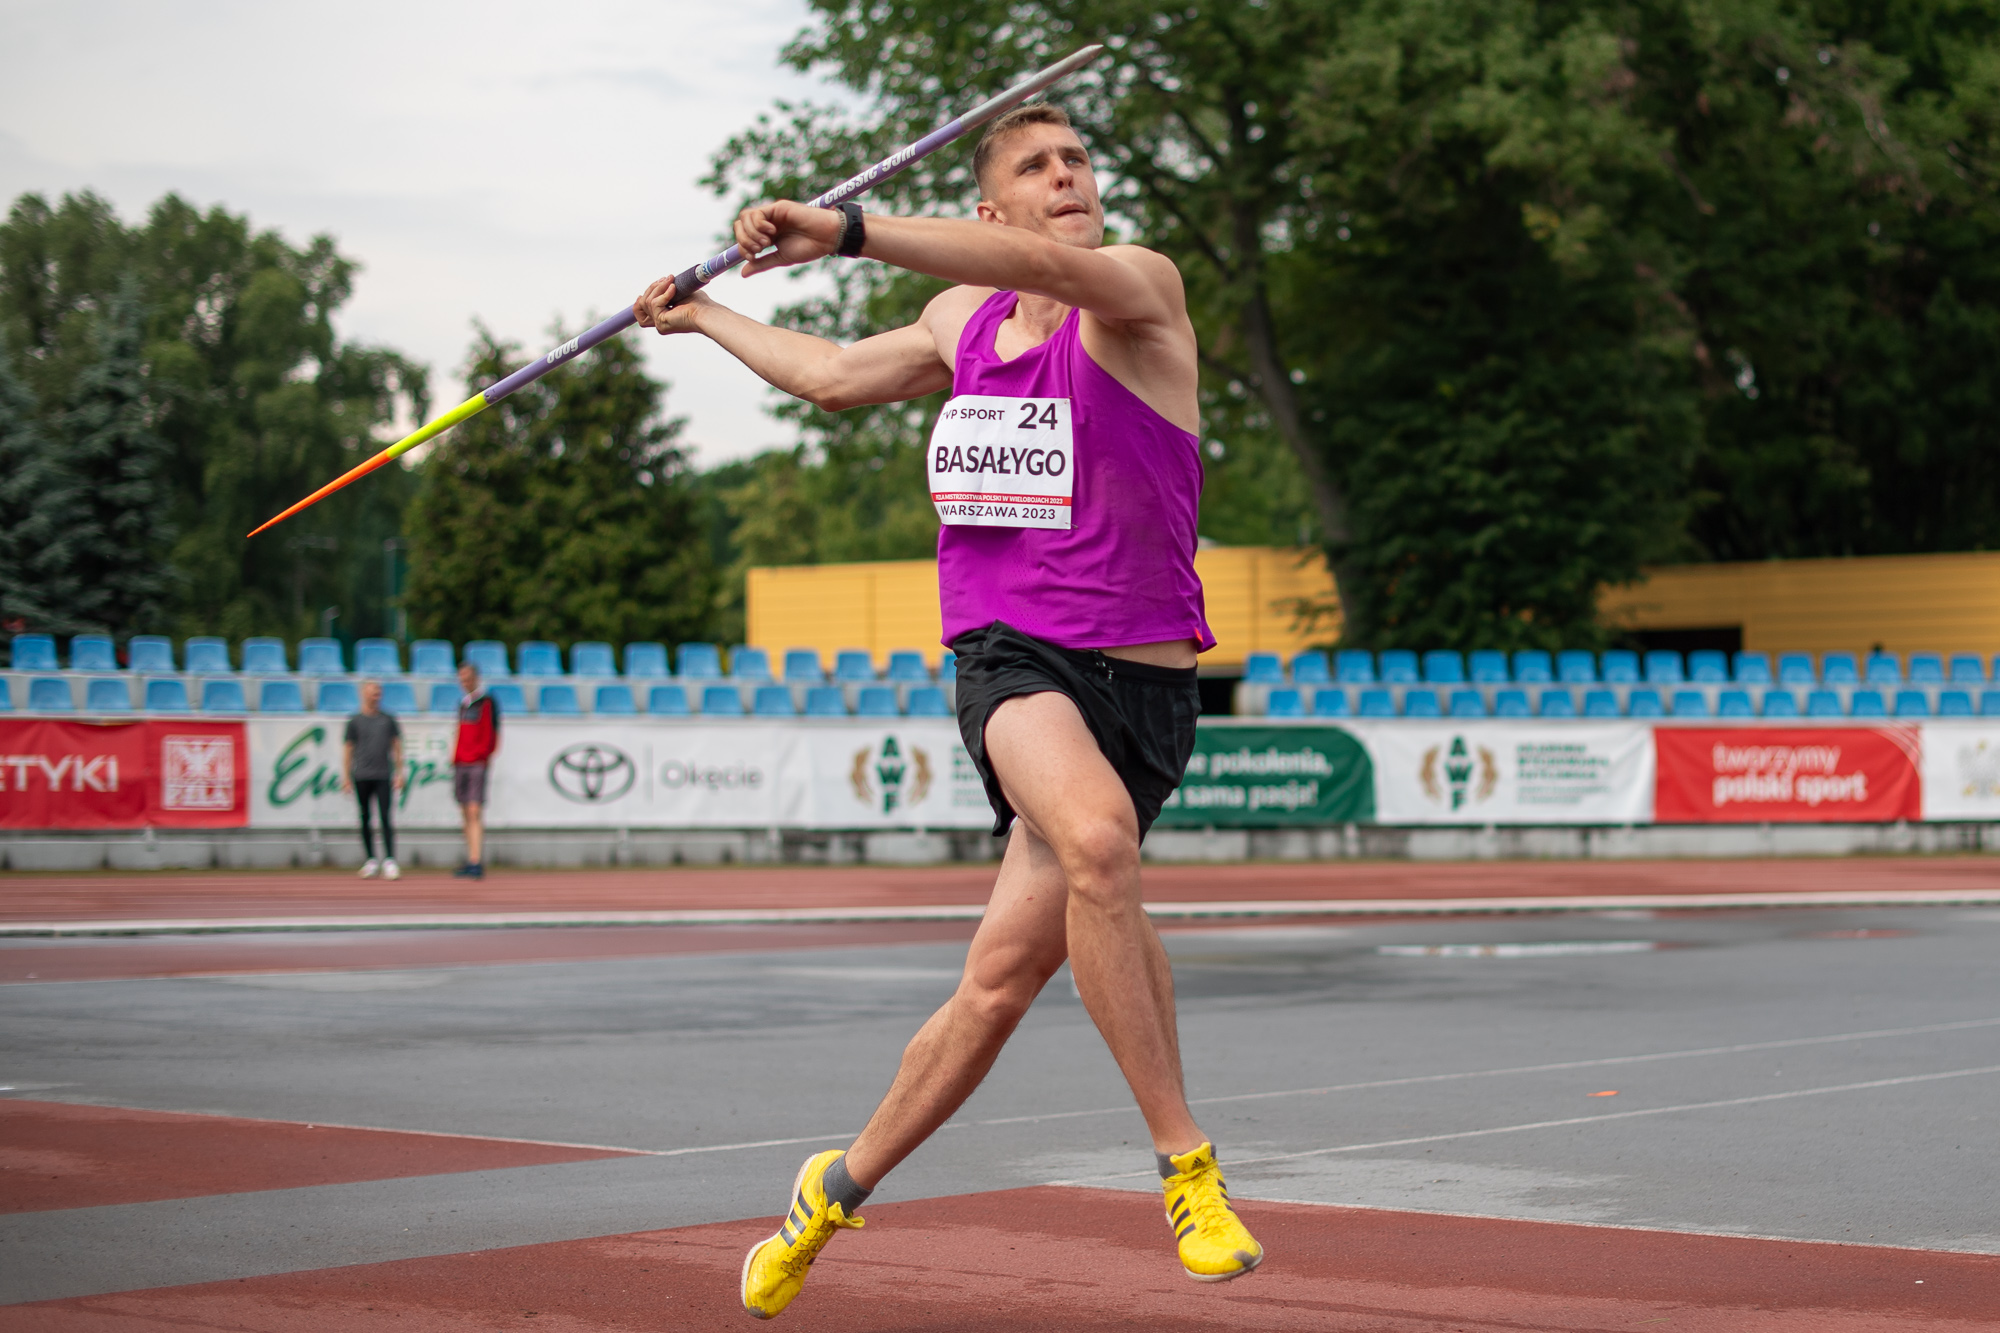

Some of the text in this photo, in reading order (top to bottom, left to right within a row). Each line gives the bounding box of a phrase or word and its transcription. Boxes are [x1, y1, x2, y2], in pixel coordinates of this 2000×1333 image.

[960, 408, 1006, 421] SPORT
[1017, 402, 1059, 431] 24
[935, 445, 1066, 477] BASAŁYGO
[940, 504, 1056, 520] WARSZAWA 2023
[0, 754, 119, 793] TYKI
